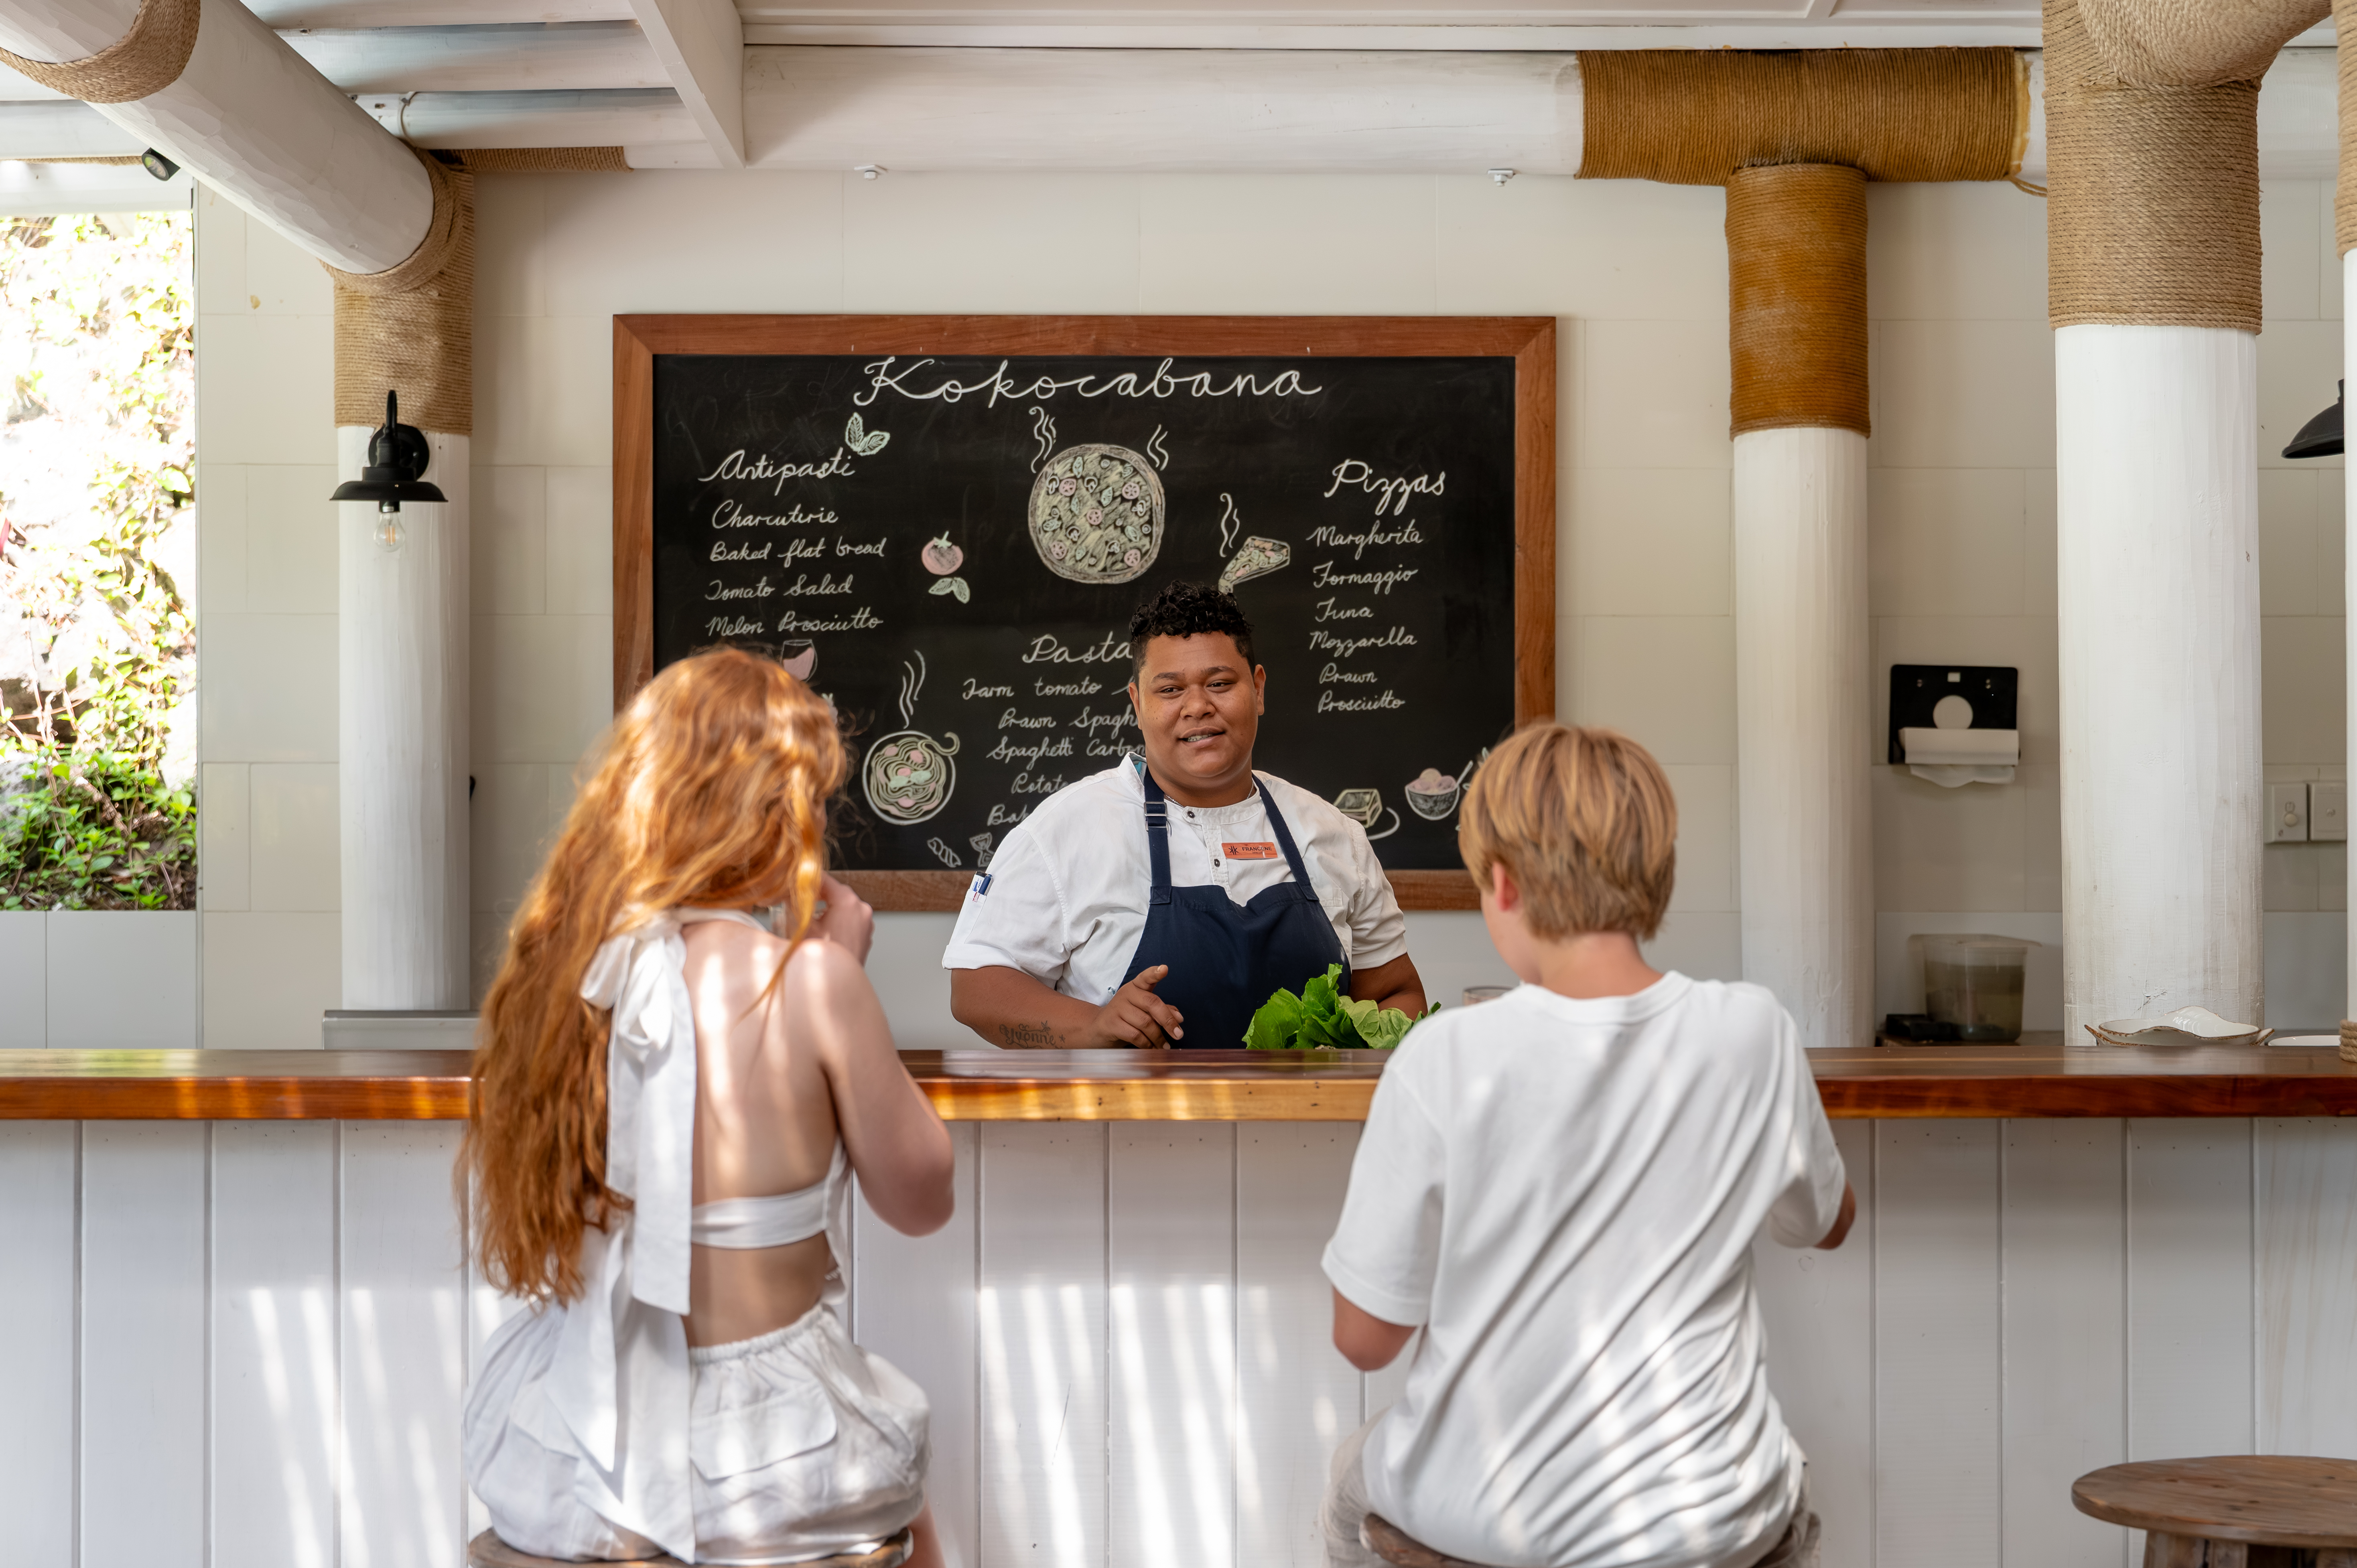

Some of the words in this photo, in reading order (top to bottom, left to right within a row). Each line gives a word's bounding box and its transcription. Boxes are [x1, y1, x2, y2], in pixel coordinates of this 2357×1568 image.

[853, 356, 1322, 409] Kokocabana
[698, 446, 857, 496] Antipasti
[1324, 458, 1446, 516] Pizzas
[712, 499, 838, 529] Charcuterie
[710, 541, 772, 562] Baked
[777, 537, 826, 568] flat
[836, 536, 887, 557] bread
[1305, 519, 1423, 560] Margherita
[705, 576, 776, 600] Tomato
[783, 573, 853, 596] Salad
[1313, 560, 1418, 595] Formaggio
[705, 616, 764, 637] Melon
[778, 607, 883, 632] Prosciutto
[1315, 596, 1374, 622] Tuna
[1309, 626, 1417, 657] Mozzarella
[1034, 676, 1102, 696] tomato
[1319, 662, 1377, 684] Prawn
[998, 707, 1056, 729] Prawn
[986, 736, 1074, 771] Spaghetti
[999, 1023, 1056, 1046] Yvonne
